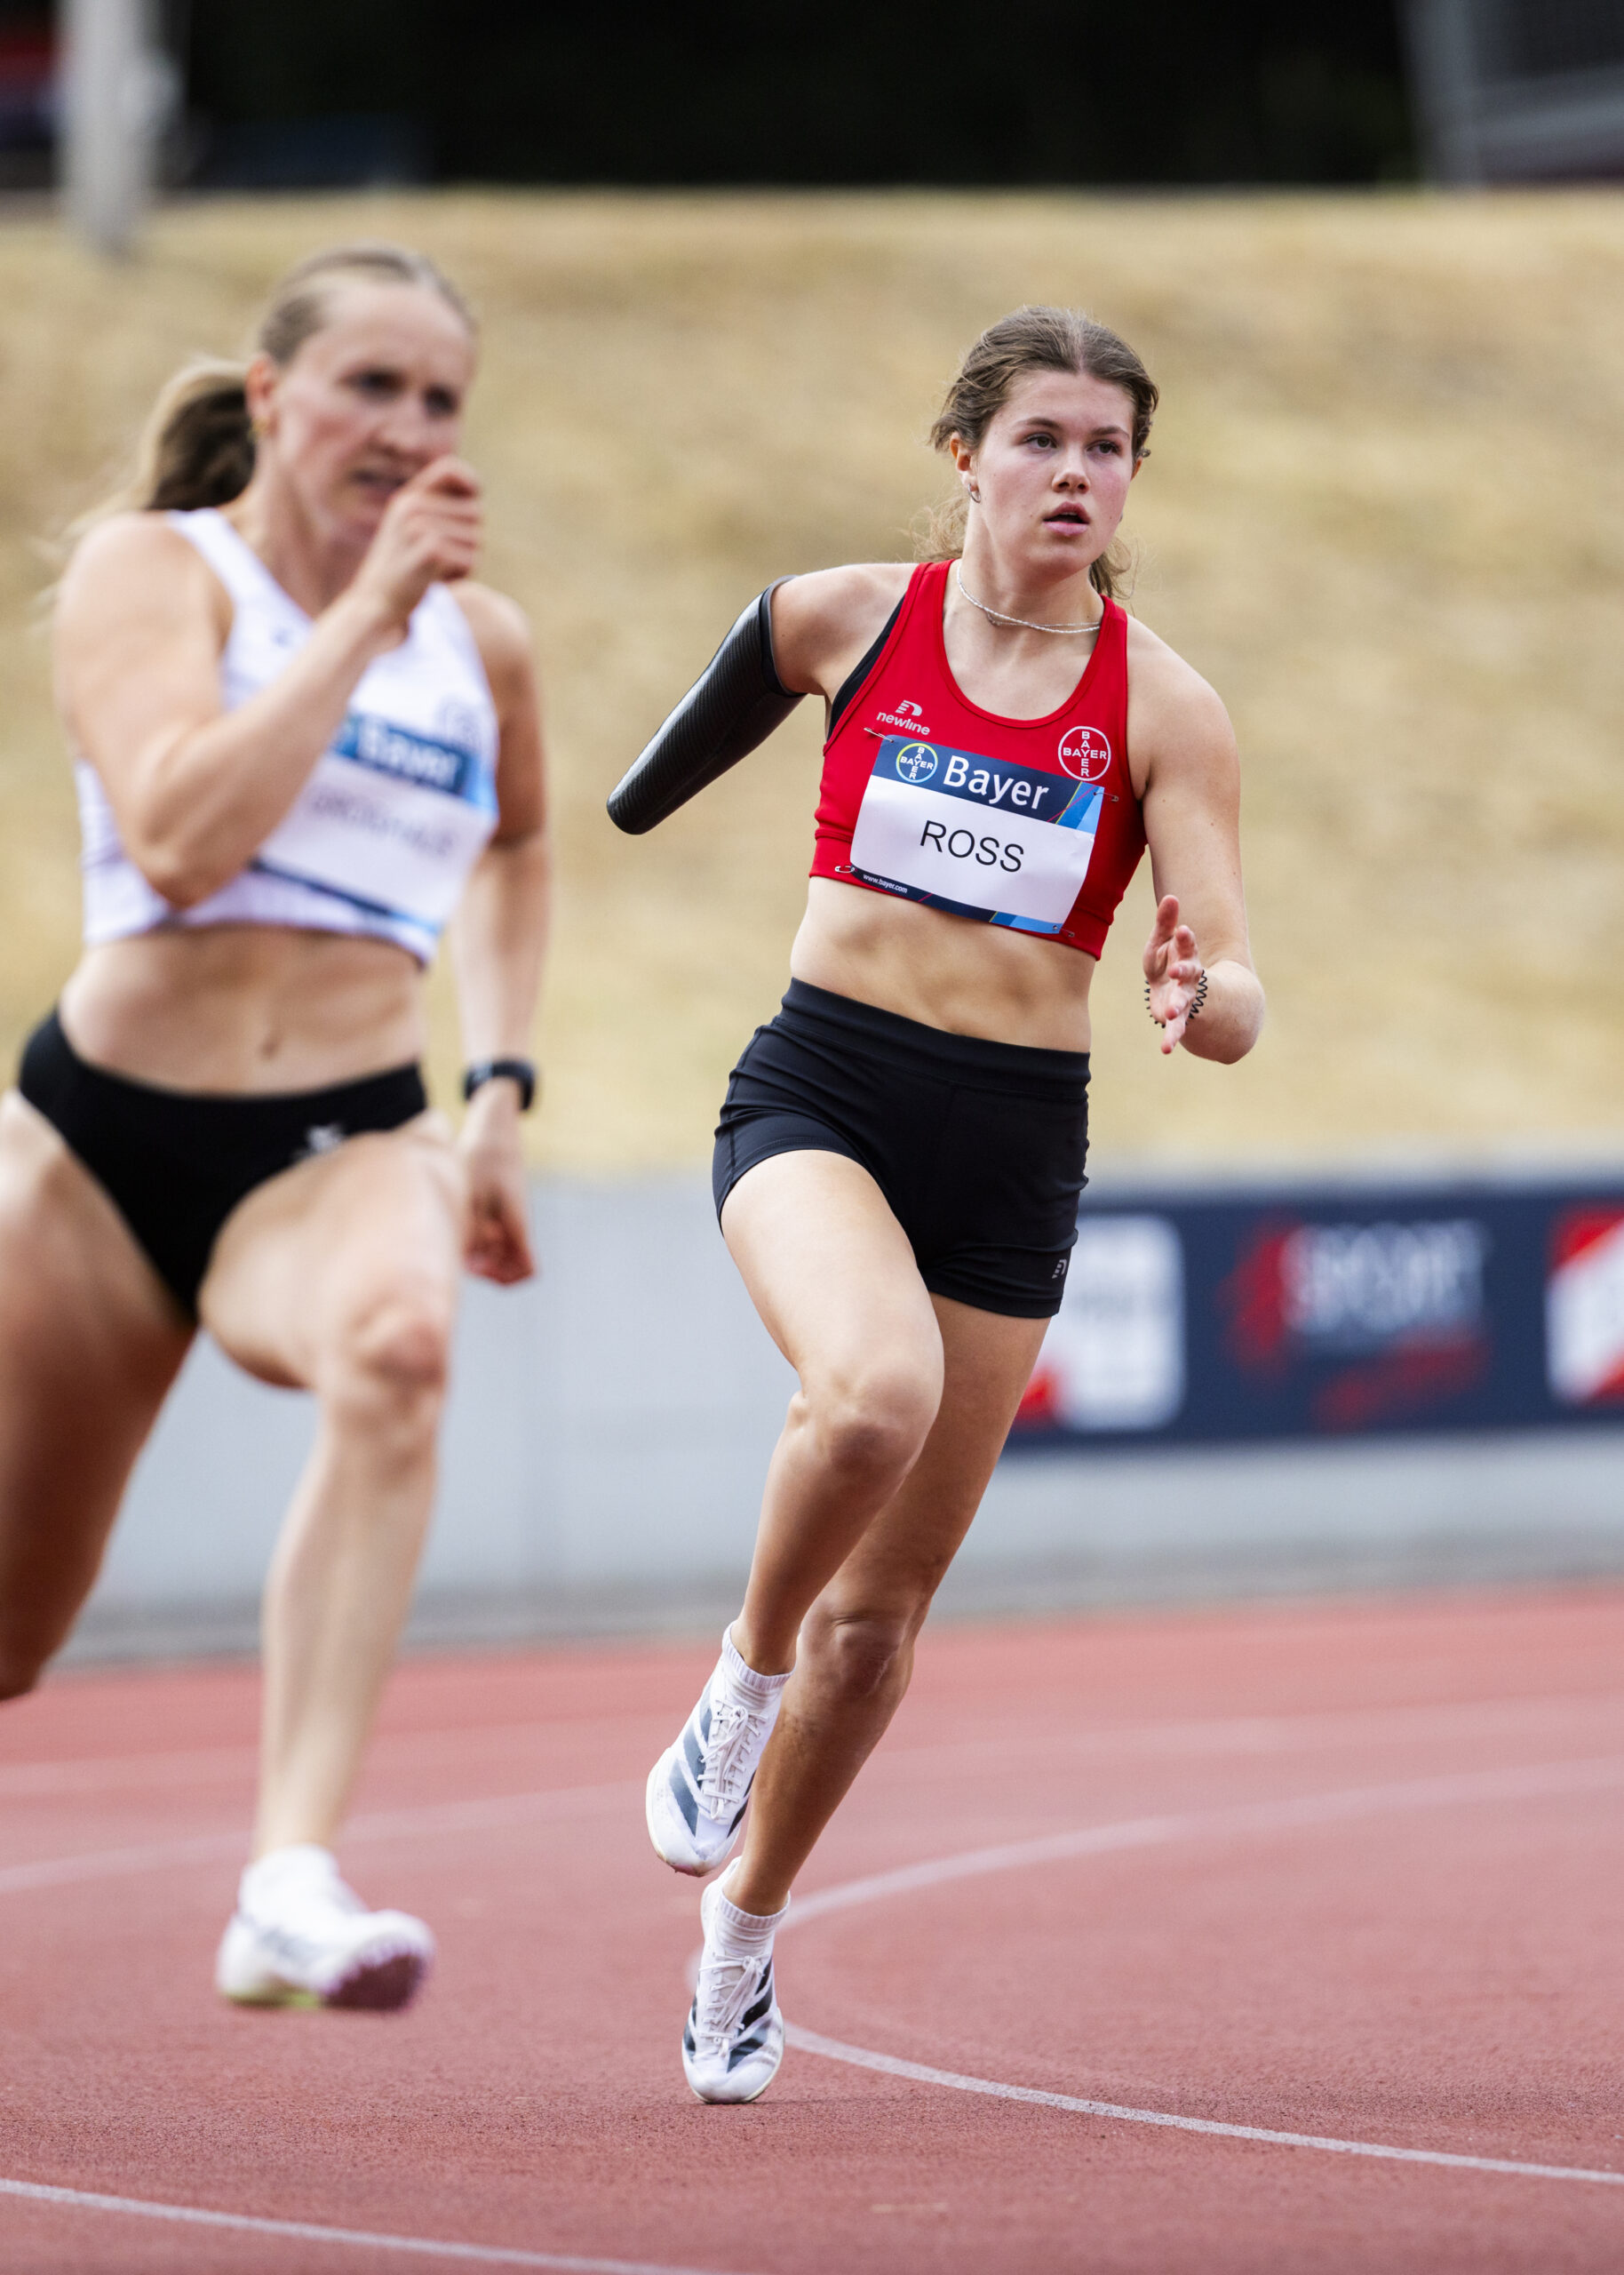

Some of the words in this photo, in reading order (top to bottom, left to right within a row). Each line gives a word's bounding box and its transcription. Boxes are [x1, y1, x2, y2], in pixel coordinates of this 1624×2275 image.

[876, 712, 930, 735] newline
[900, 755, 934, 770] BAYER
[909, 746, 925, 779] BAYER
[1063, 746, 1107, 760] BAYER
[1080, 730, 1091, 777] BAYER
[943, 755, 1049, 810] Bayer
[919, 820, 1024, 873] ROSS
[863, 874, 908, 893] www.bayer.com
